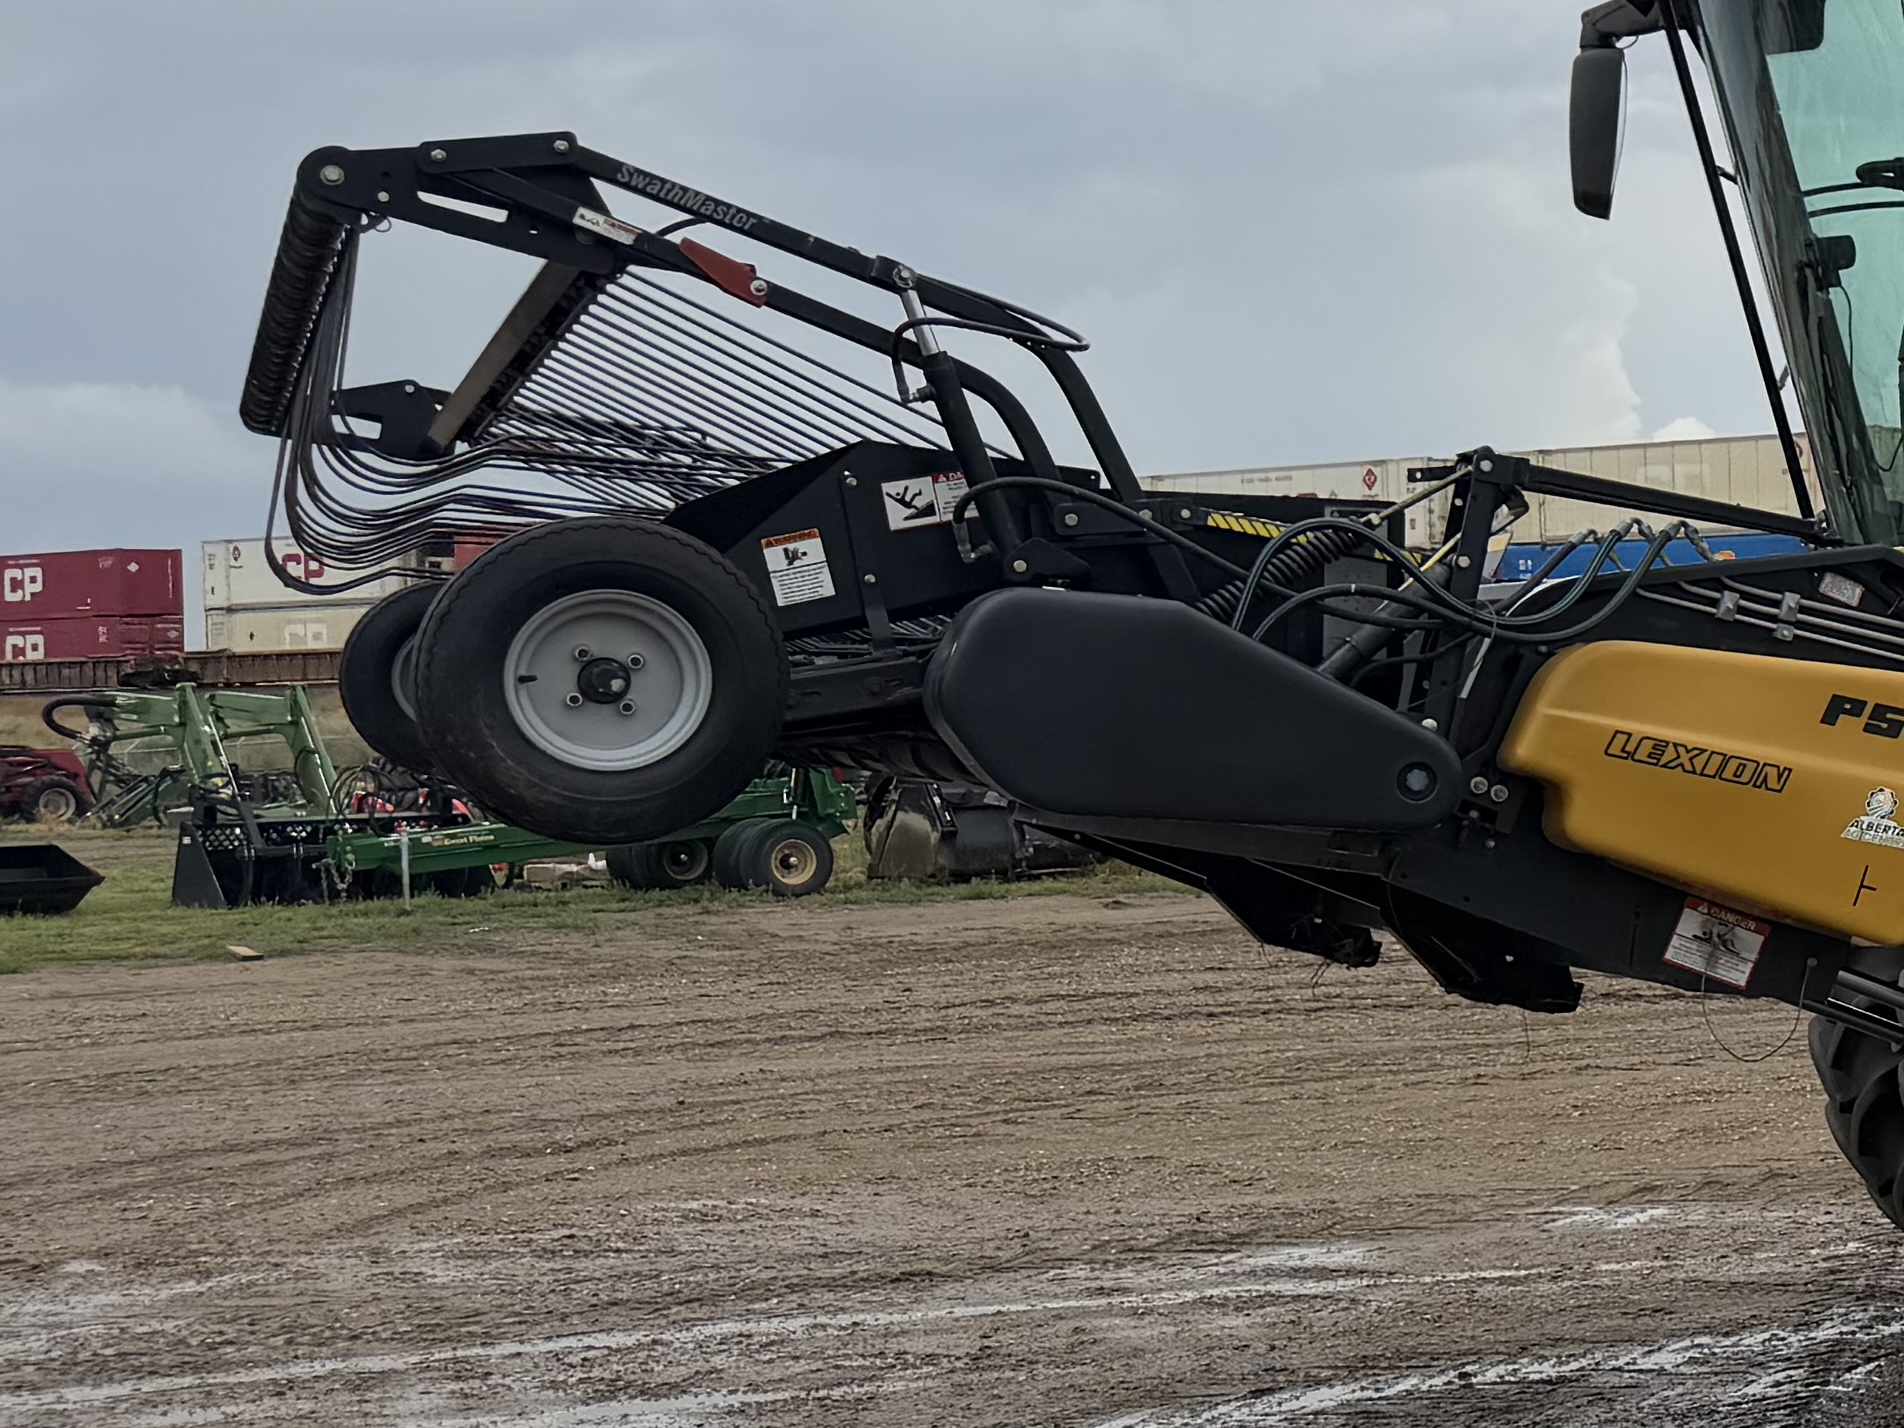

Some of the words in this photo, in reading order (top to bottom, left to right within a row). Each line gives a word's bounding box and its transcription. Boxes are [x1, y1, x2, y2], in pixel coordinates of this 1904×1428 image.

[616, 163, 758, 231] SwathMaster
[4, 567, 43, 601] CP
[5, 634, 45, 661] CP
[1604, 729, 1793, 794] LEXION
[1710, 907, 1757, 931] DANGER
